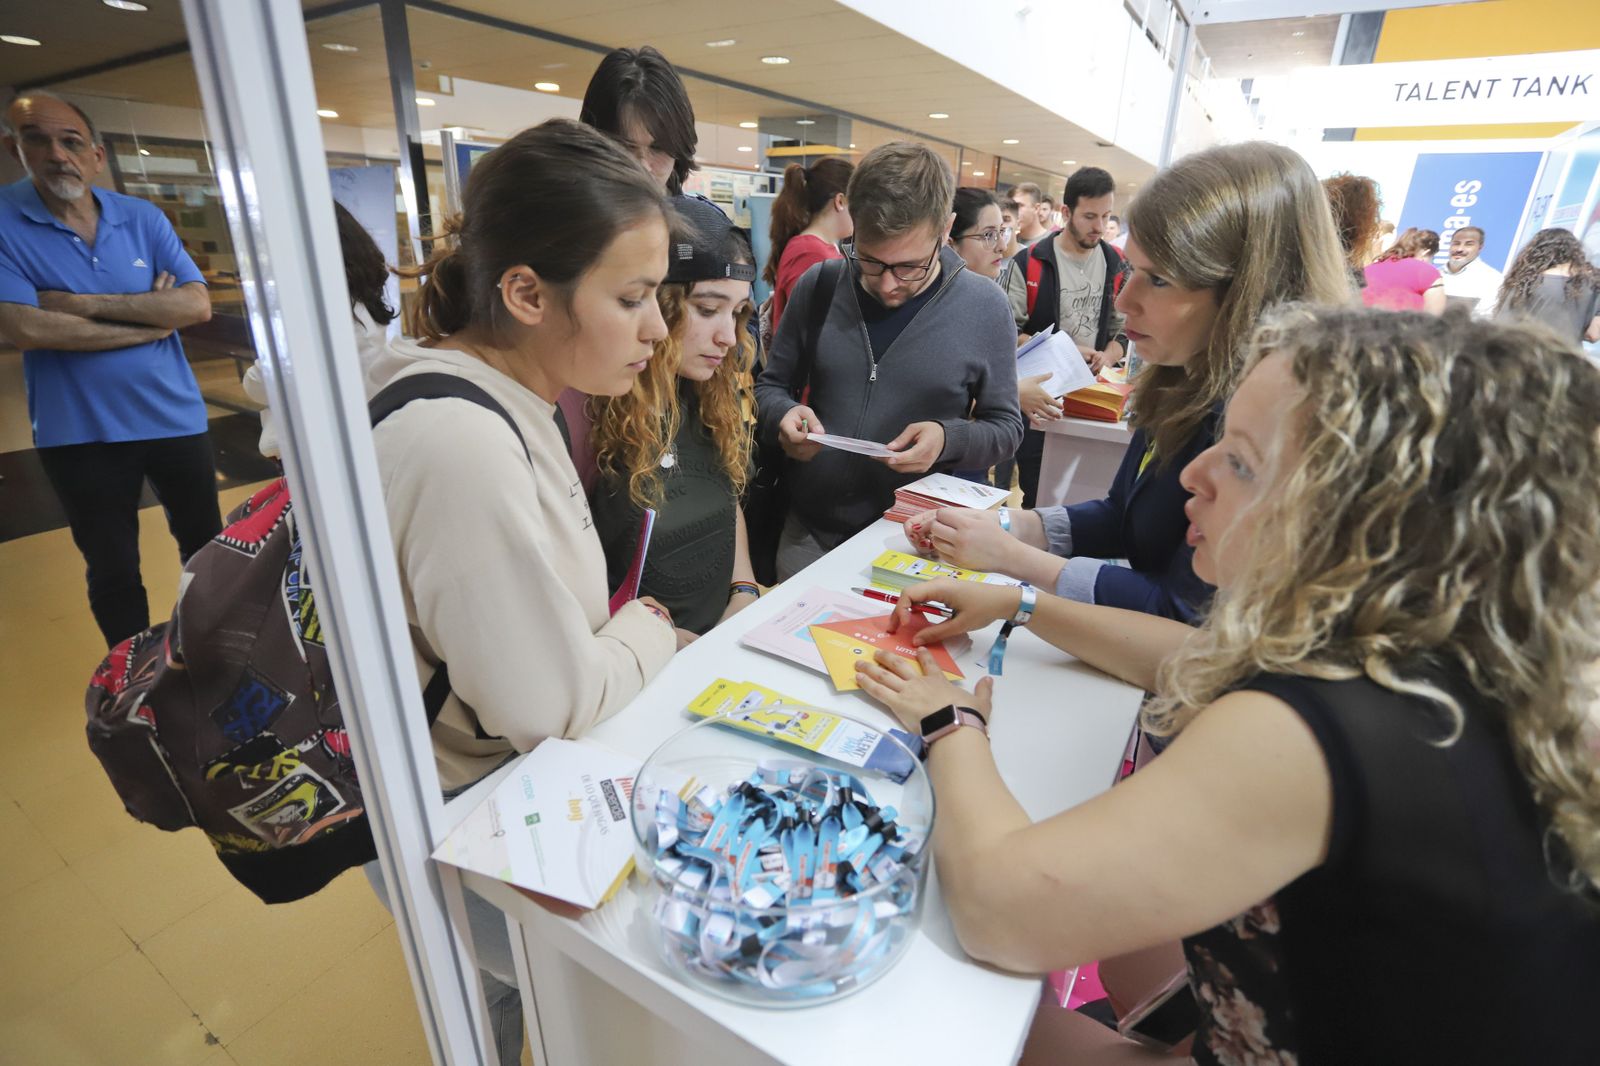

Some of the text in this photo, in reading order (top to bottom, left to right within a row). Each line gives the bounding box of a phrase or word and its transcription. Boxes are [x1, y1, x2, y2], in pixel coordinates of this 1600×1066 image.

[1395, 74, 1593, 102] TALENT TANK
[852, 731, 879, 758] TALENT
[567, 798, 584, 821] hoy
[600, 780, 625, 821] depende
